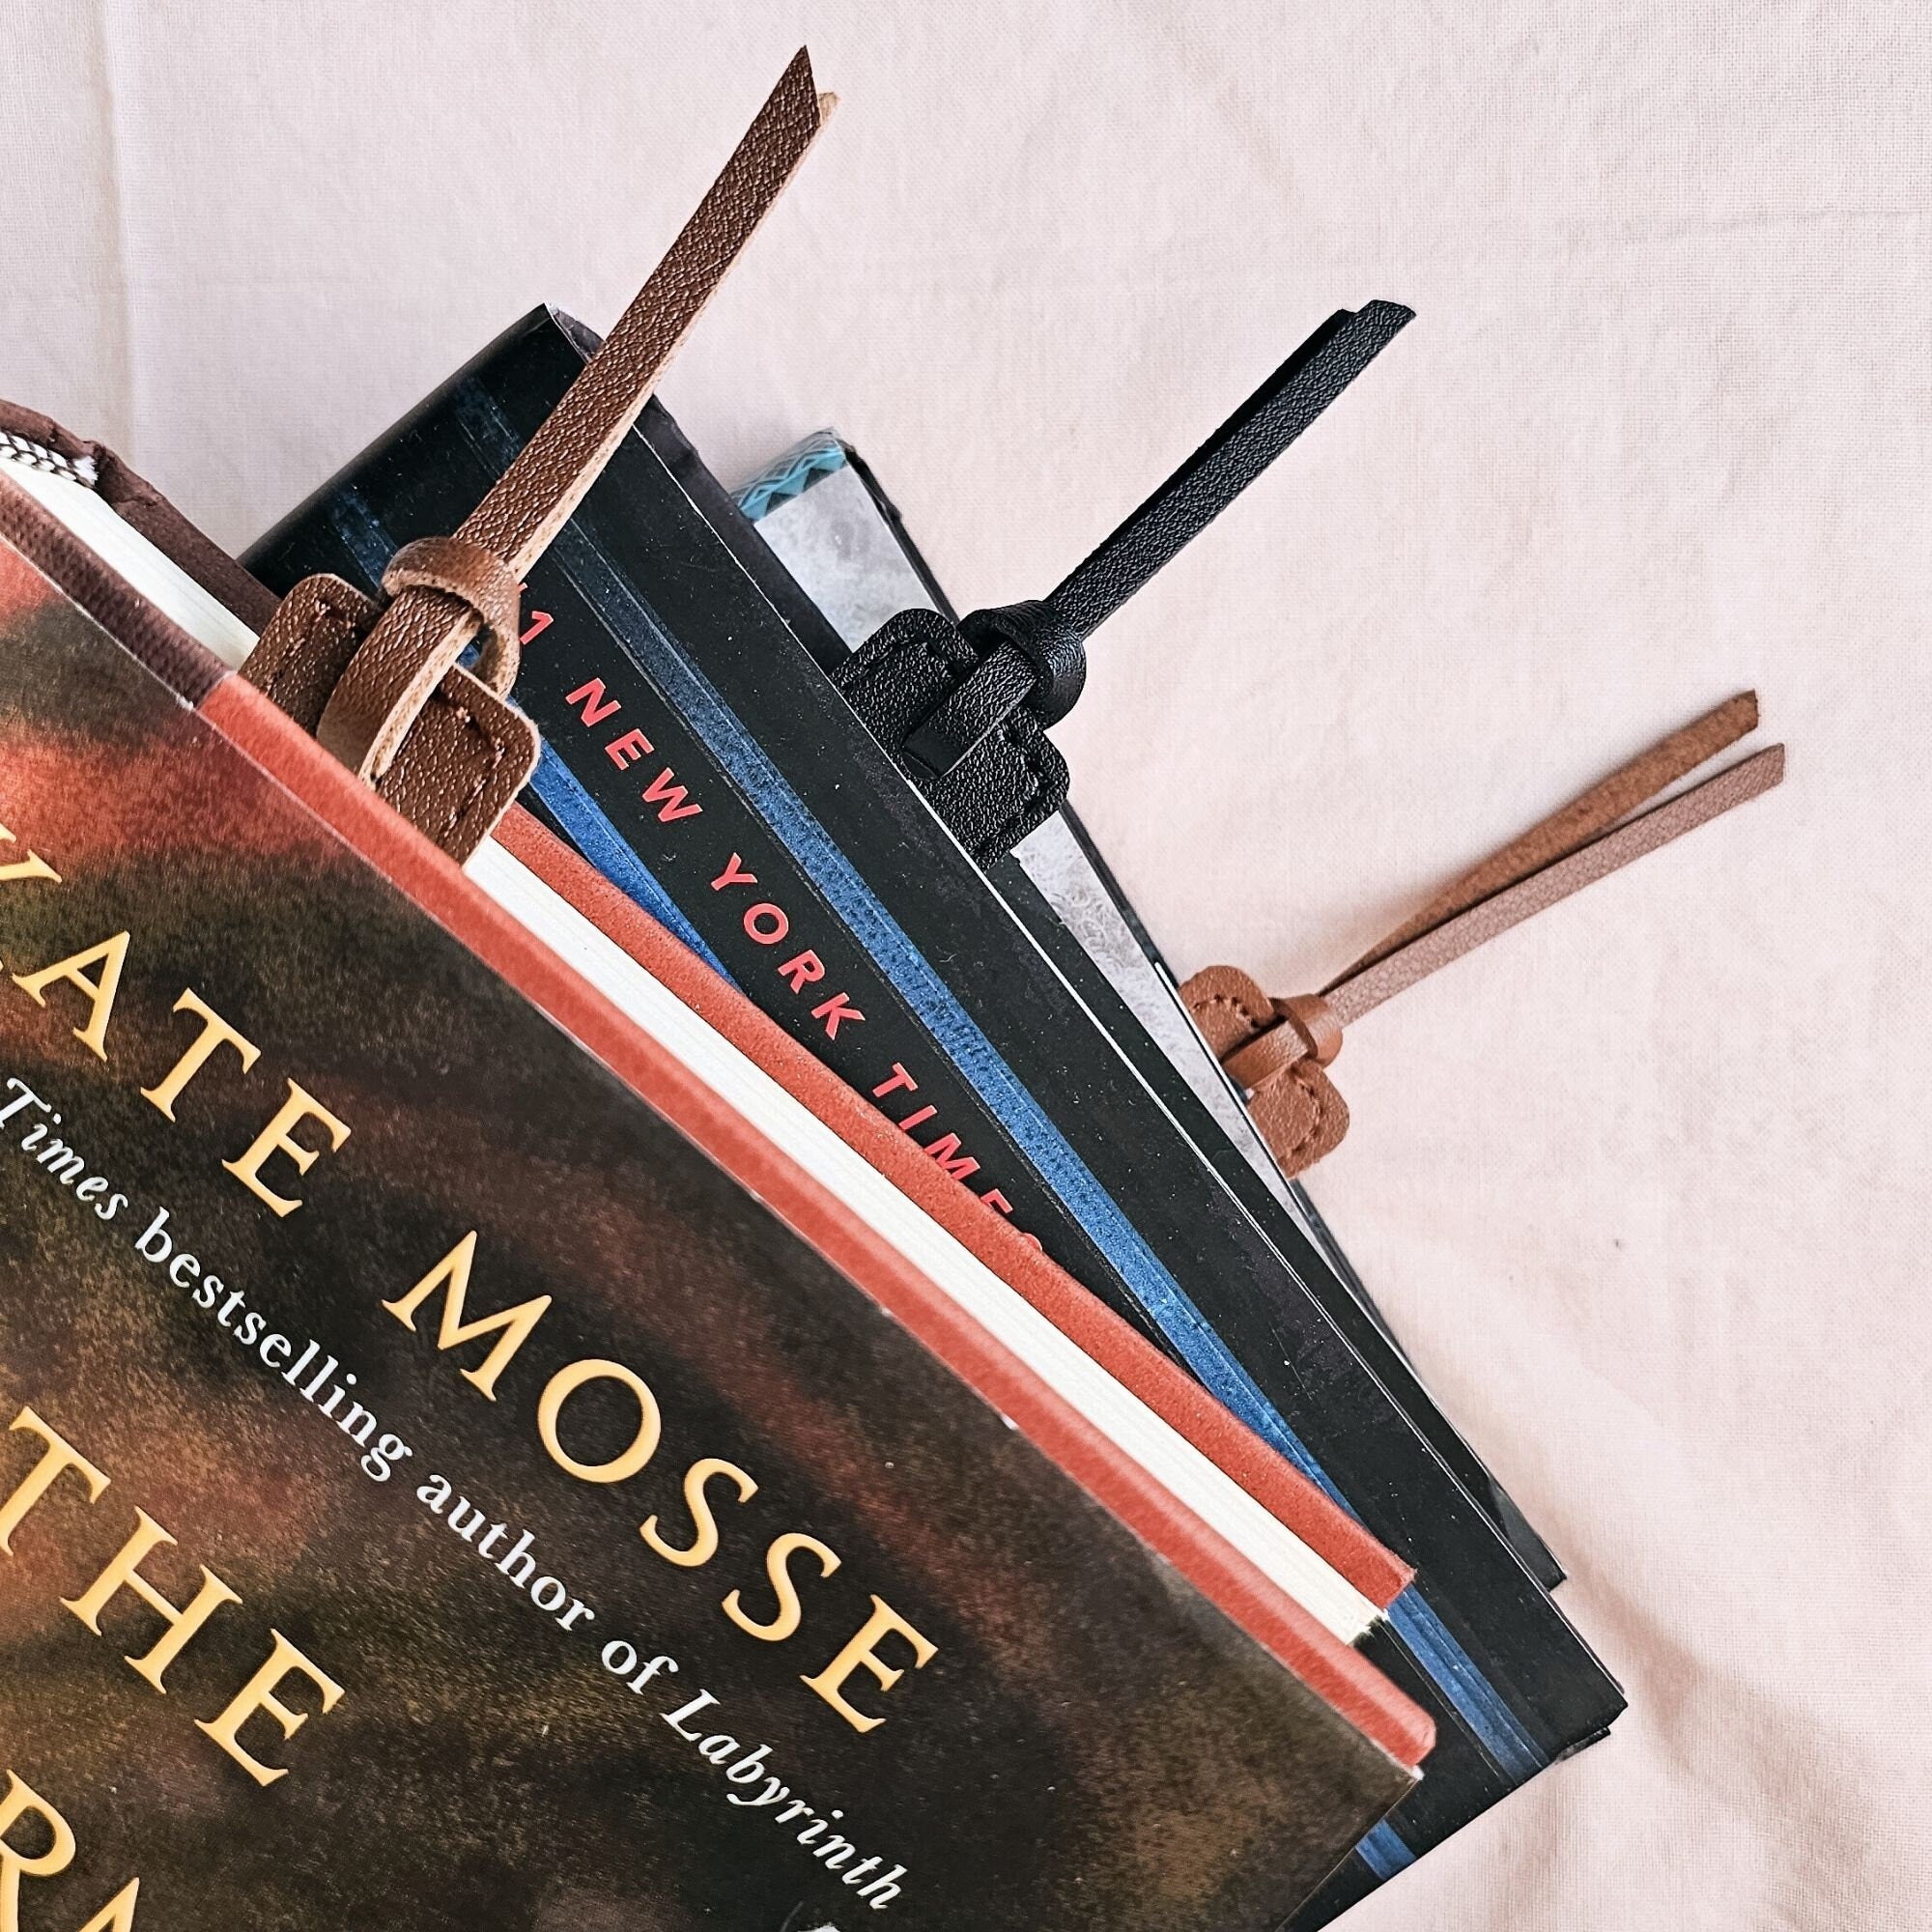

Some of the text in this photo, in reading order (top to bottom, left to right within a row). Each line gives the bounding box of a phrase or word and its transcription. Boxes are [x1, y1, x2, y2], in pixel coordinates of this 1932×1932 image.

[565, 677, 703, 824] NEW
[710, 853, 867, 1041] YORK
[0, 1077, 908, 1910] Times bestselling author of Labyrinth
[0, 1406, 346, 1787] THE
[382, 1231, 939, 1734] MOSSE
